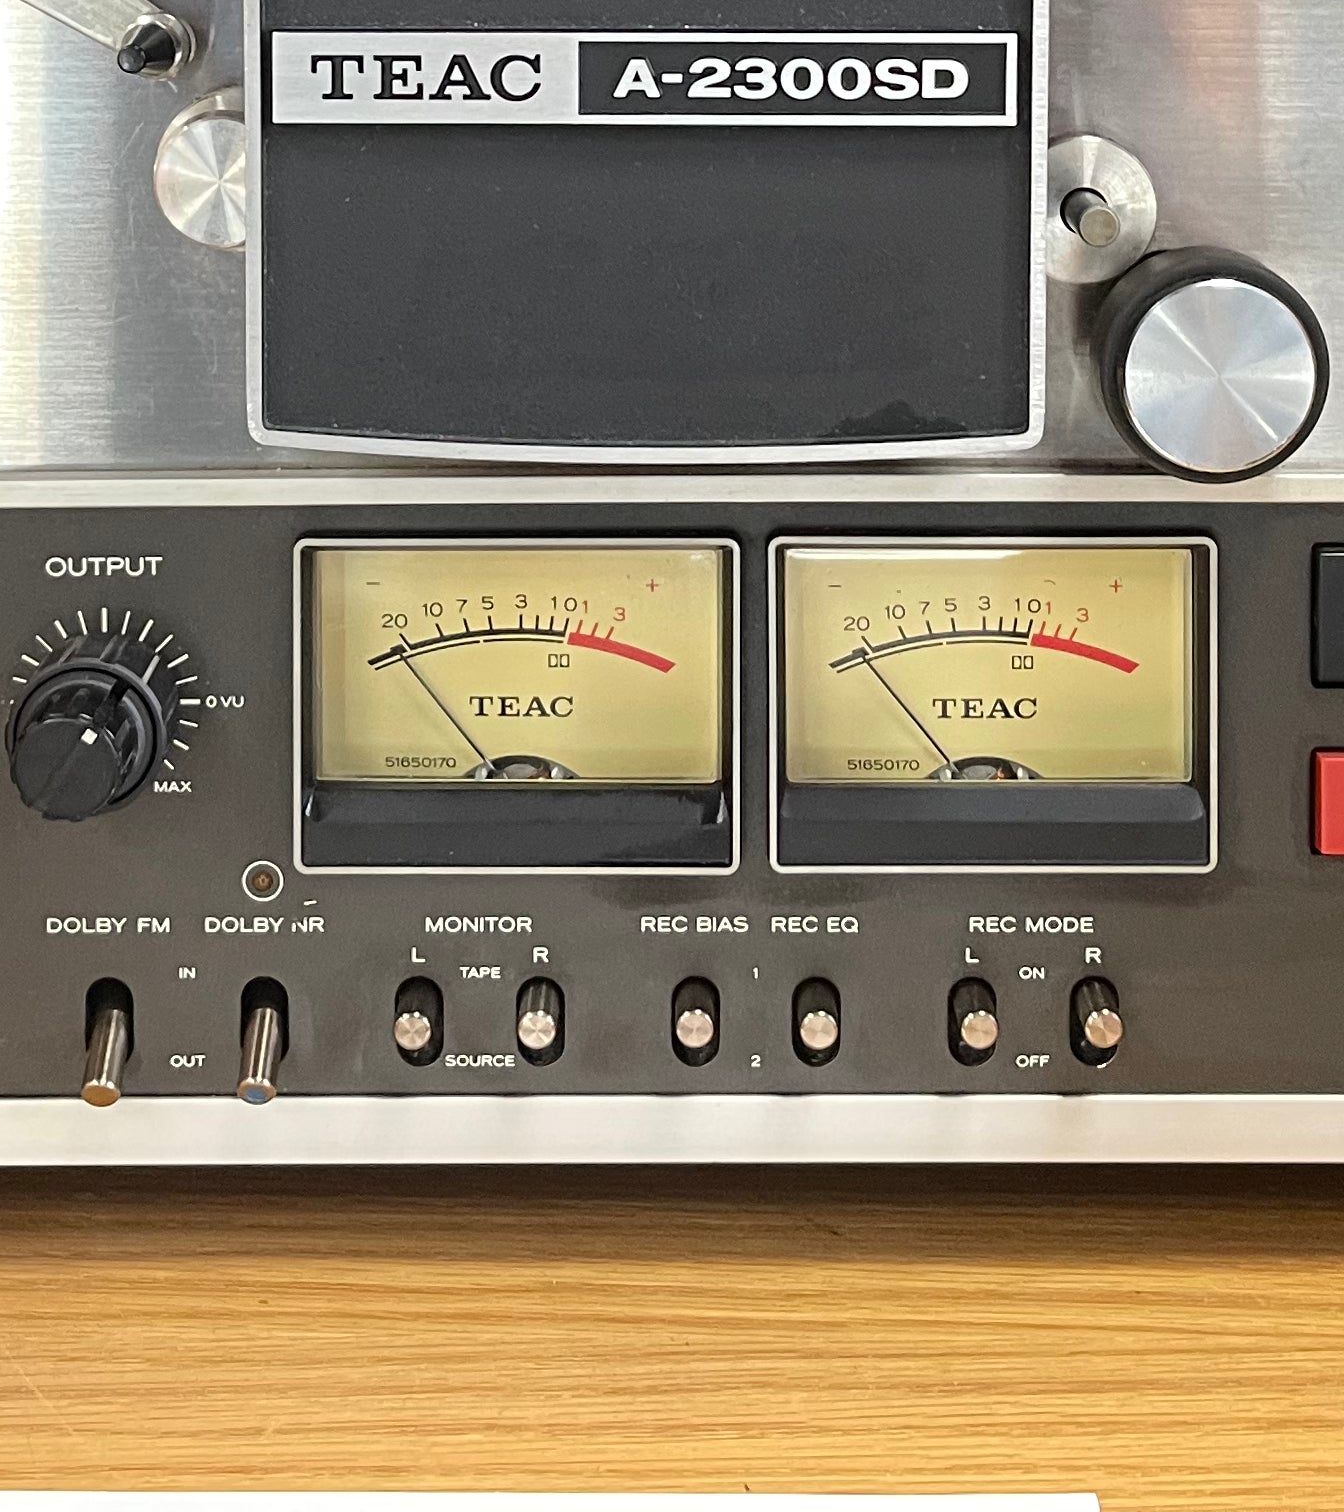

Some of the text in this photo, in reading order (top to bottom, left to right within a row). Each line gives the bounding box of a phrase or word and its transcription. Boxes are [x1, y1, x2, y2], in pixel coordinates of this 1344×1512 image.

[310, 53, 969, 102] TEAC A-2300SD
[44, 556, 163, 578] OUTPUT
[381, 613, 408, 629] 20
[421, 601, 444, 618] 10
[456, 599, 468, 613] 7
[481, 595, 494, 611] 5
[514, 593, 528, 609] 3
[582, 599, 588, 614] 1
[613, 606, 626, 622] 3
[843, 615, 870, 632] 20
[884, 604, 906, 620] 10
[920, 601, 931, 615] 7
[944, 597, 958, 613] 5
[977, 595, 991, 611] 3
[1045, 601, 1052, 615] 1
[1076, 607, 1090, 623] 3
[220, 695, 245, 708] VU
[469, 696, 574, 718] TEAC
[932, 697, 1037, 720] TEAC
[385, 756, 457, 768] 51650170
[847, 759, 920, 771] 51650170
[153, 780, 192, 793] MAX
[46, 916, 171, 935] DOLBY FM
[204, 916, 325, 933] DOLBY NR
[425, 916, 533, 933] MONITOR
[640, 915, 749, 933] REC BIAS
[771, 915, 859, 934] REC EQ
[968, 916, 1094, 934] REC MODE
[411, 946, 426, 963] L
[532, 946, 549, 964] R
[965, 947, 980, 964] L
[1085, 947, 1102, 964] R
[178, 967, 196, 979] IN
[459, 966, 502, 979] TAPE
[752, 967, 759, 980] 1
[1018, 966, 1045, 980] ON
[168, 1054, 206, 1068] OUT
[444, 1054, 516, 1068] SOURCE
[750, 1054, 761, 1068] 2
[1015, 1054, 1050, 1068] OFF
